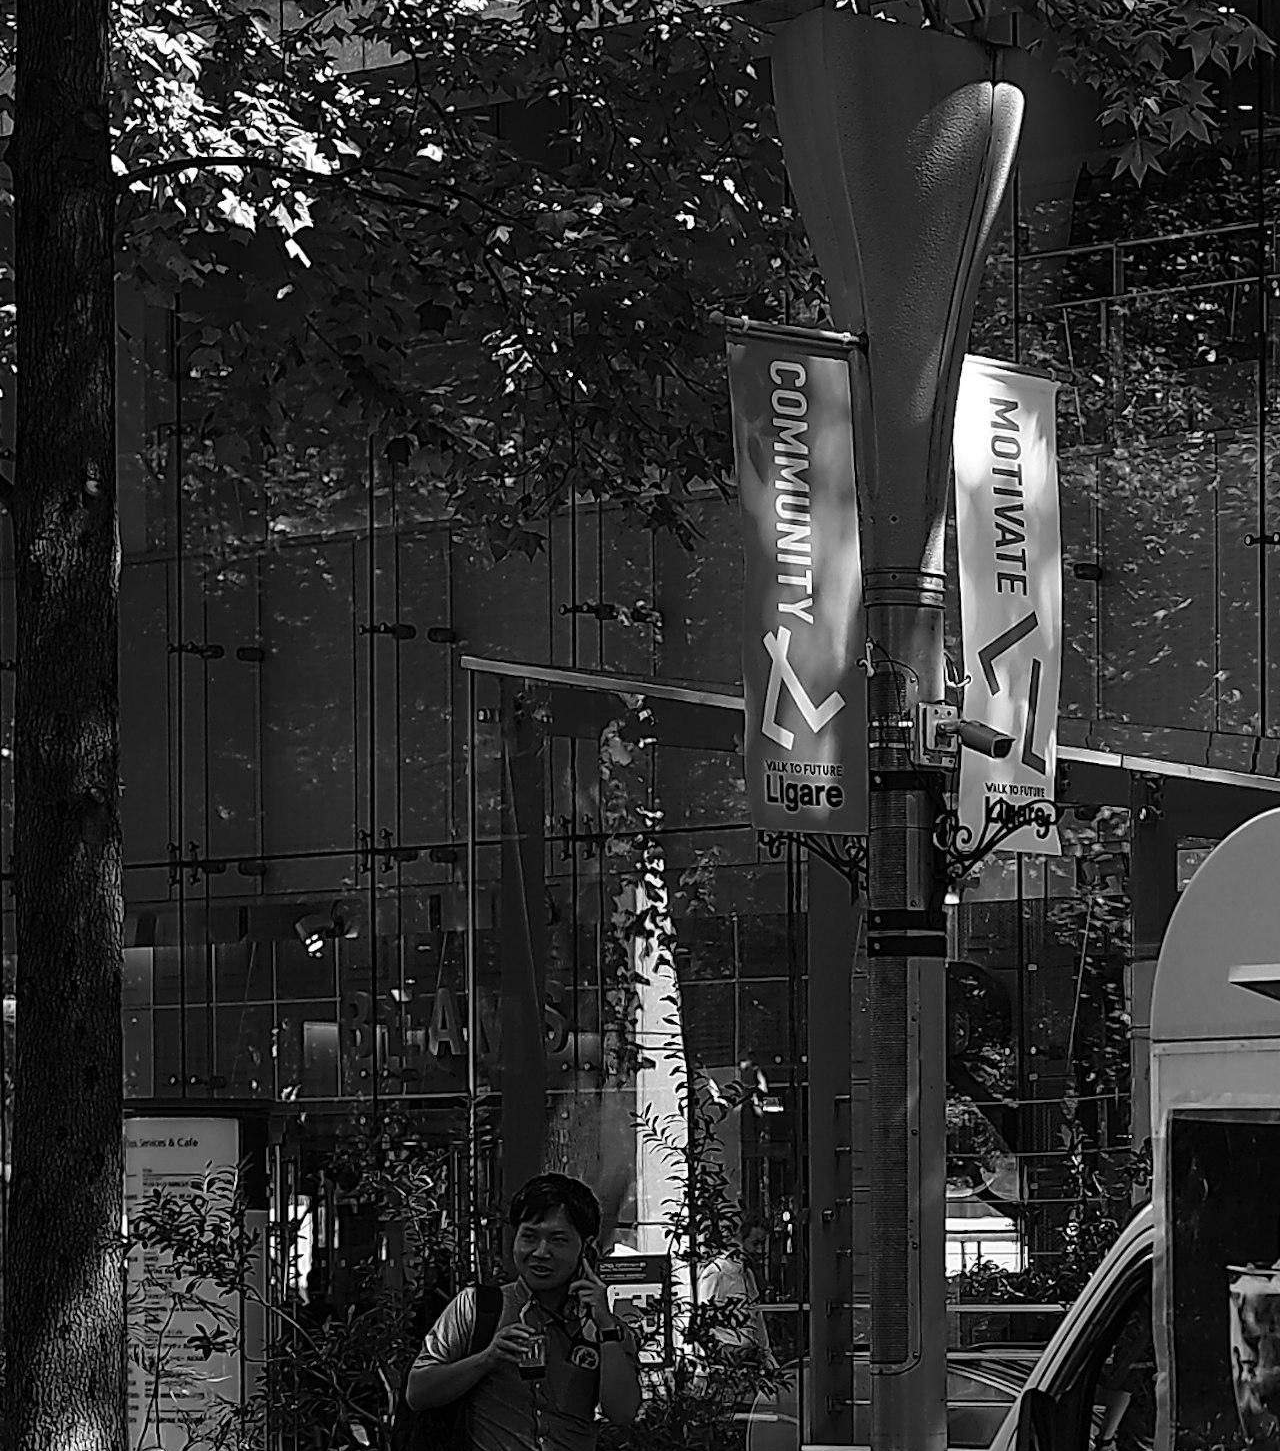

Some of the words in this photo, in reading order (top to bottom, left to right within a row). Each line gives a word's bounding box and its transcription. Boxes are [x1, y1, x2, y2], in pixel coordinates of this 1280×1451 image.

[769, 360, 814, 625] COMMUNITY
[989, 397, 1028, 596] MOTIVATE
[790, 762, 802, 773] TO
[803, 764, 843, 777] FUTURE
[766, 774, 844, 812] Ligare
[1009, 784, 1019, 795] TO
[1020, 785, 1045, 798] FUTURE
[168, 1137, 175, 1147] &
[177, 1137, 199, 1148] Cafe
